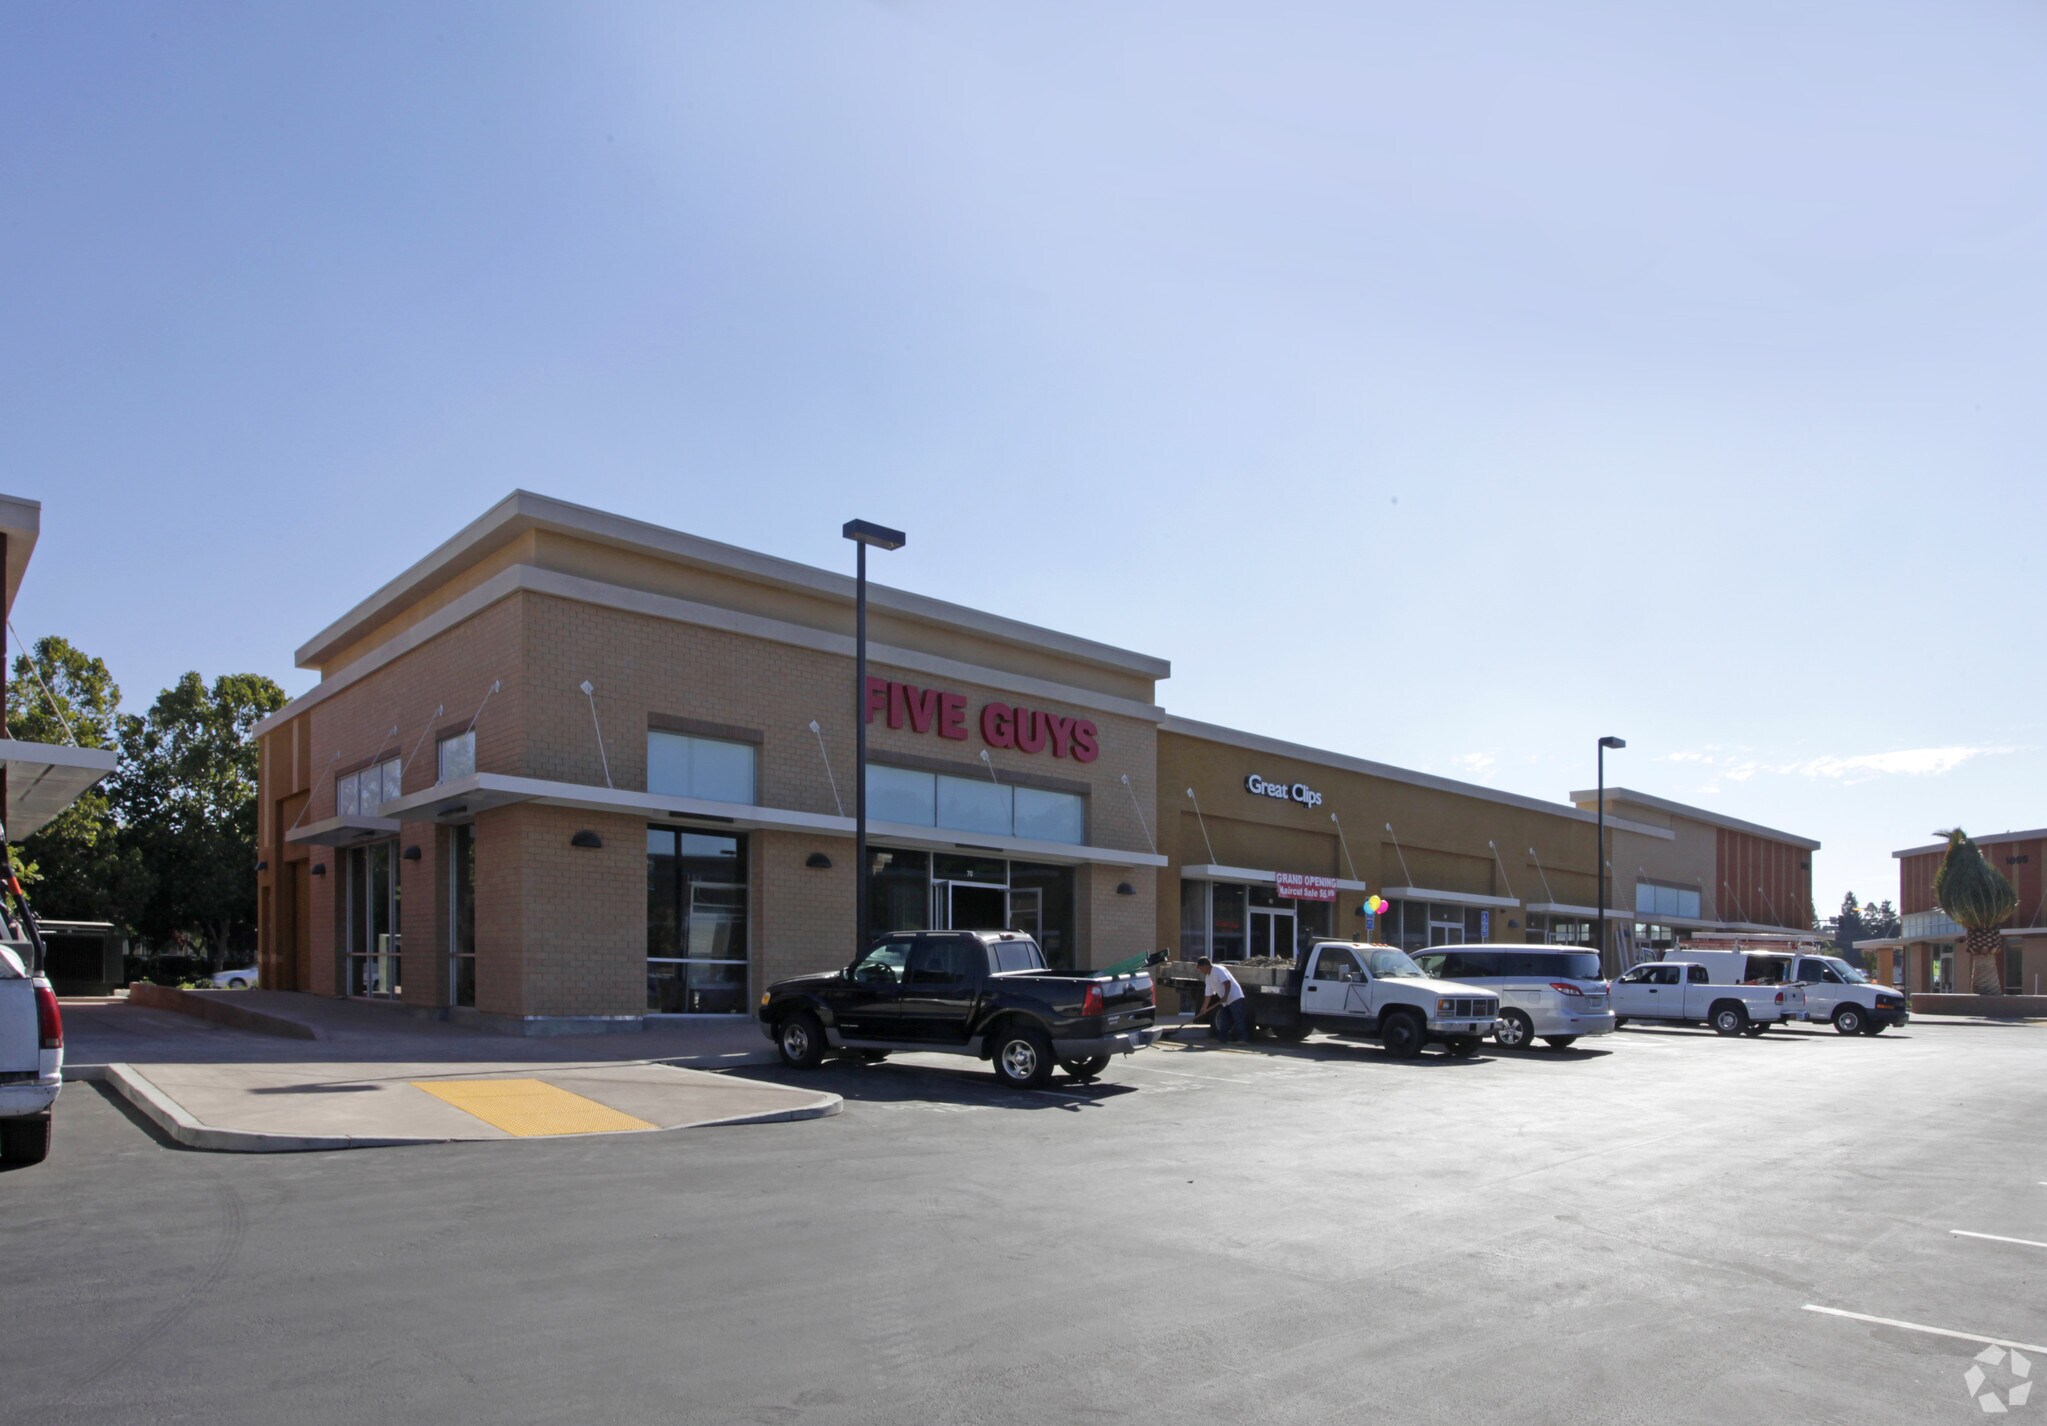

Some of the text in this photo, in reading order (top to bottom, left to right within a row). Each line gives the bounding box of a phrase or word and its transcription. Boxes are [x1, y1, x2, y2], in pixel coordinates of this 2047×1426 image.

[865, 675, 1099, 763] FIVE GUYS
[1247, 774, 1322, 808] Great Clips
[1276, 873, 1337, 888] GRAND OPENING
[1279, 885, 1303, 896] Haircut
[1304, 887, 1319, 897] Sale
